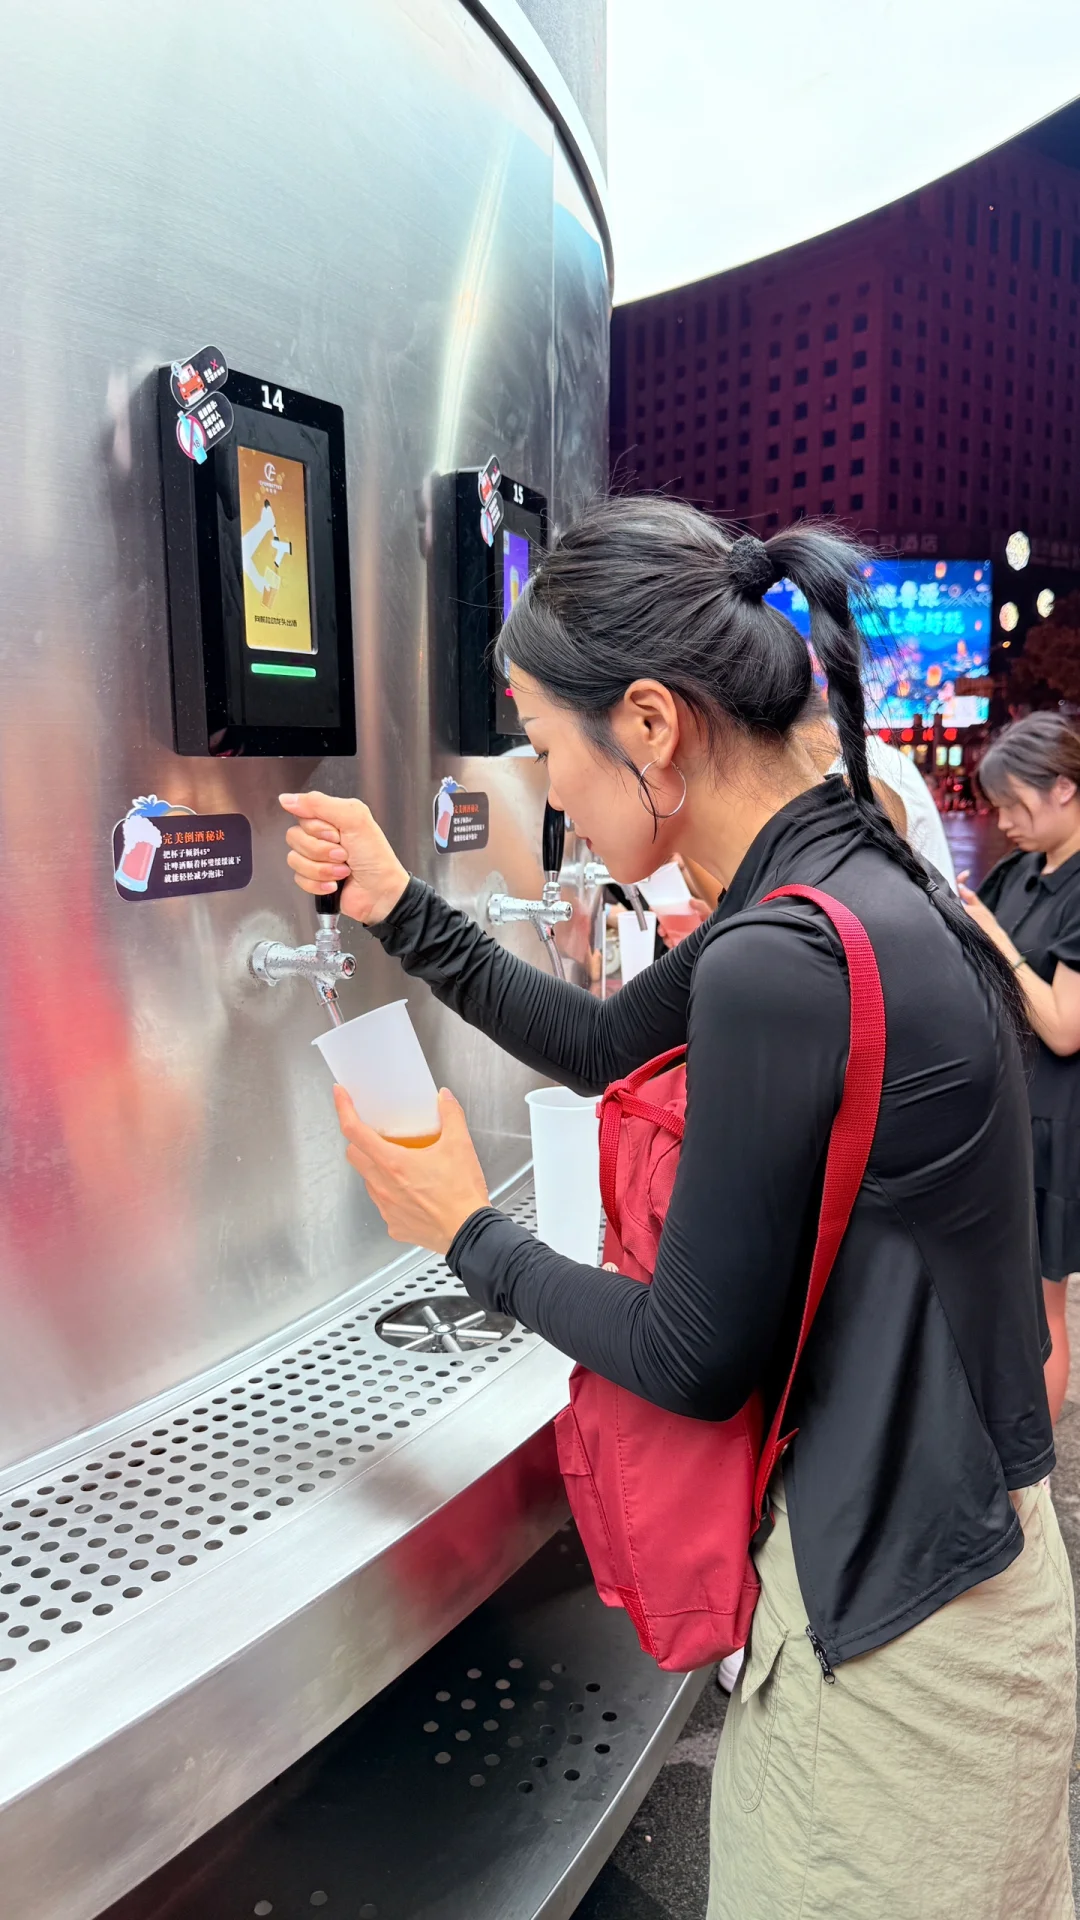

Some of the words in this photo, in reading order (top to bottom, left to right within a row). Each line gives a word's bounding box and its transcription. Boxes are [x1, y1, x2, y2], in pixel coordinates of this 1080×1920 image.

[261, 385, 285, 412] 14
[513, 483, 524, 505] 15
[163, 830, 225, 844] 完美倒酒秘诀
